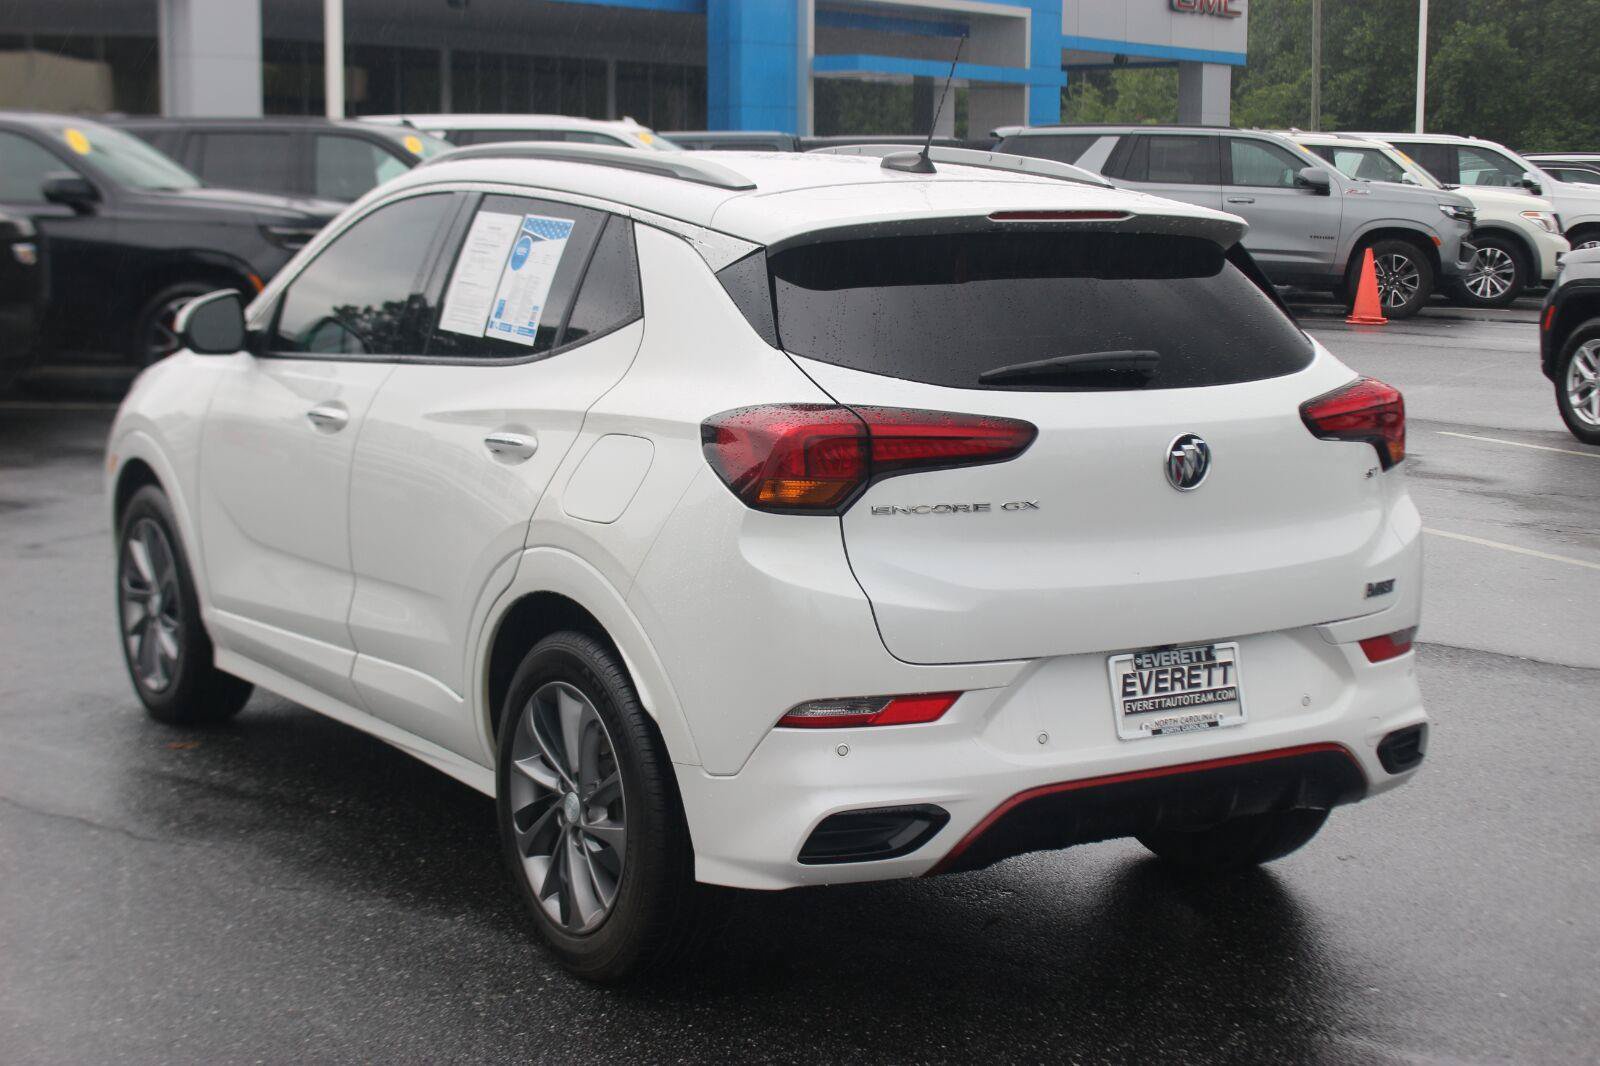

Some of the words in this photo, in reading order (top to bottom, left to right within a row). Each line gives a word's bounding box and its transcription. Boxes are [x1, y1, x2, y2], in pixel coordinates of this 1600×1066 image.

[871, 503, 991, 516] ENCORE
[1000, 499, 1040, 511] GX
[1141, 647, 1208, 668] EVERETT
[1122, 661, 1233, 697] EVERETT
[1125, 689, 1236, 713] EVERETTAUTOTEAM.COM
[1154, 718, 1178, 727] NORTH
